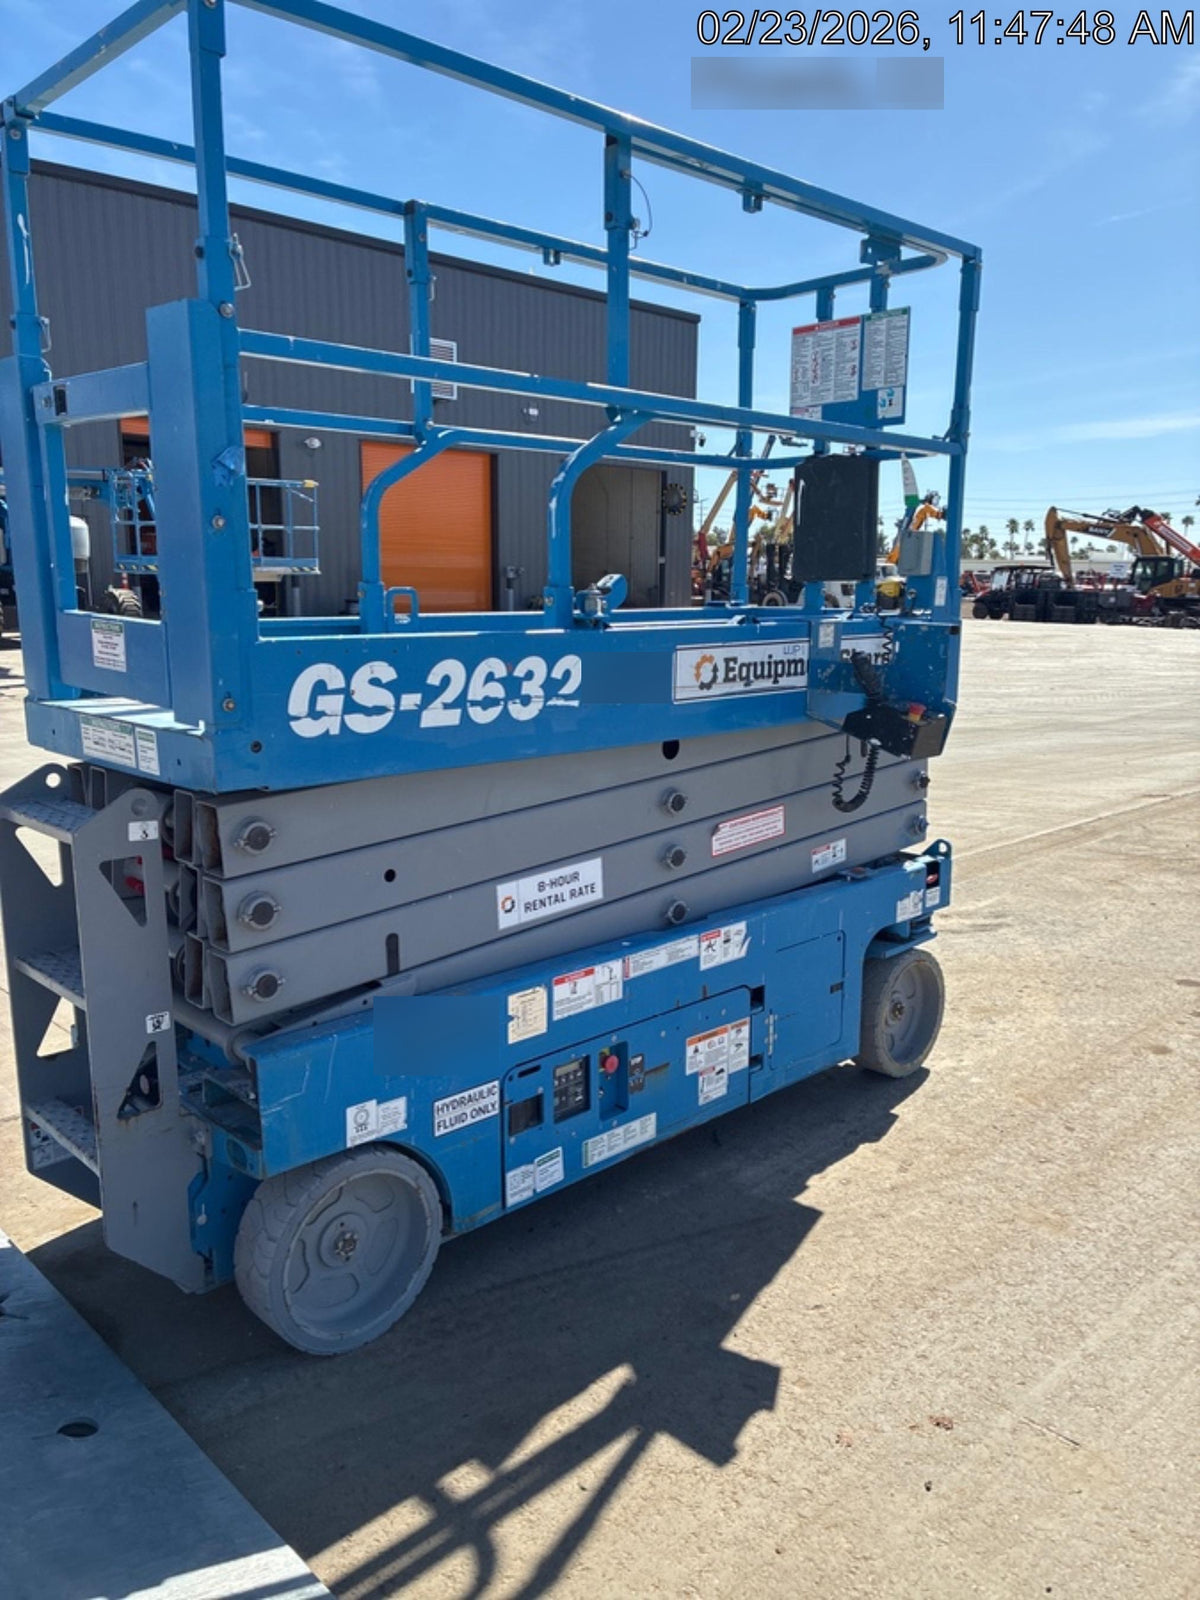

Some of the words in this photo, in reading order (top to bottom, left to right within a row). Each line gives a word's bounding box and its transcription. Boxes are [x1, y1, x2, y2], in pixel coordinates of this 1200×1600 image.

[723, 654, 808, 687] Equipm
[287, 654, 582, 738] GS-2632
[537, 871, 580, 893] 8-HOUR
[523, 891, 566, 913] RENTAL
[569, 883, 596, 899] RATE
[436, 1084, 497, 1116] HYDRAULIC
[436, 1112, 468, 1132] FLUID
[470, 1101, 497, 1119] ONLY
